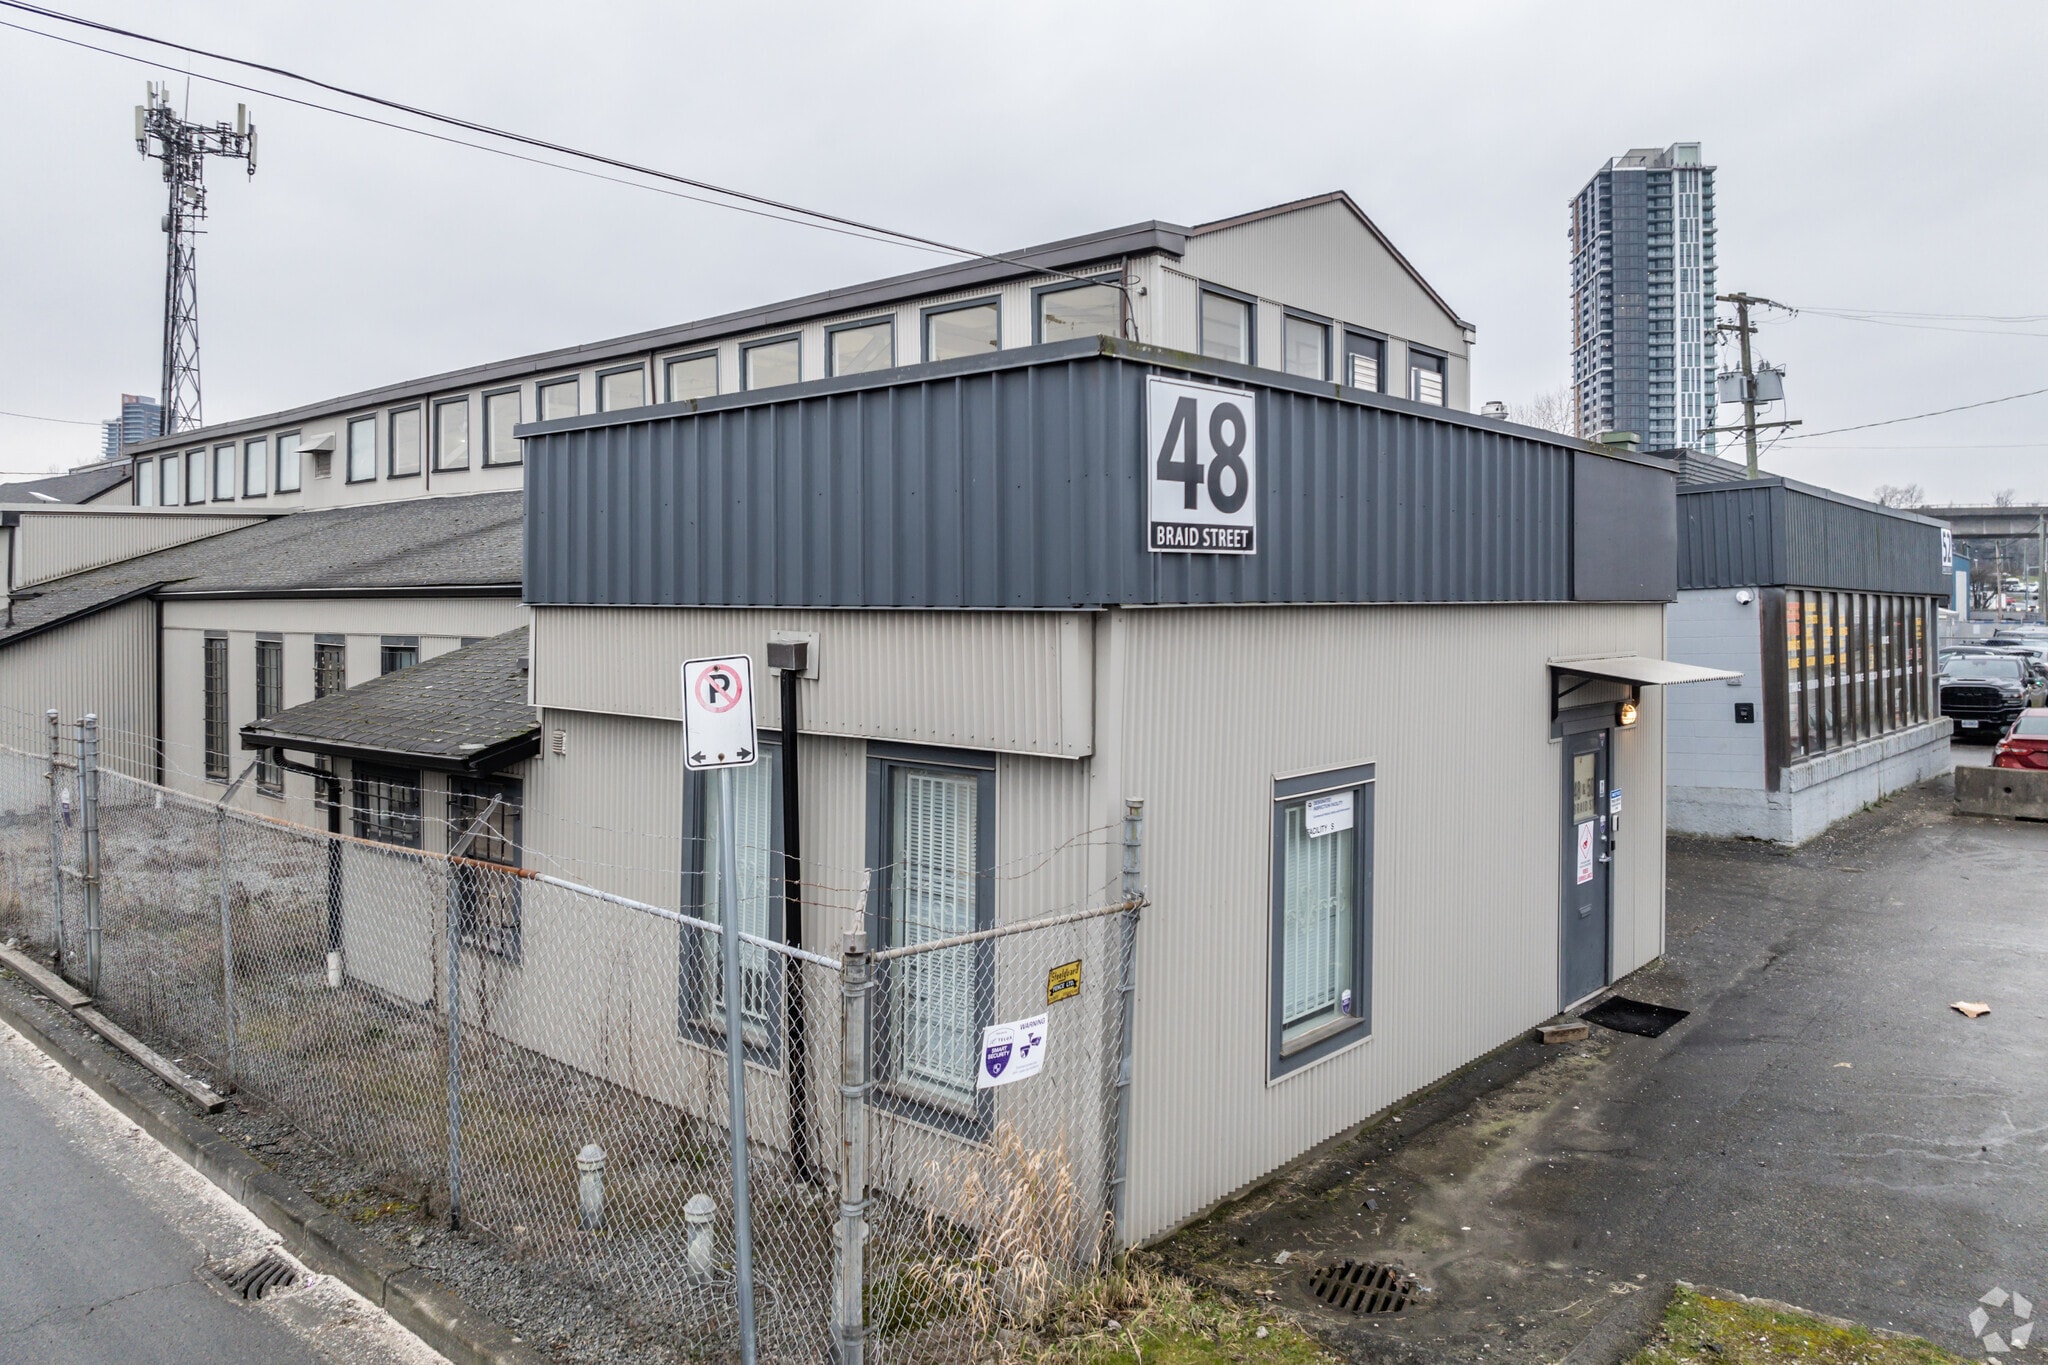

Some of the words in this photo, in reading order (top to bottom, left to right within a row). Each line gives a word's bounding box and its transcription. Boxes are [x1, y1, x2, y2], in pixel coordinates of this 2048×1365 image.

[1157, 396, 1248, 514] 48
[1157, 526, 1199, 546] BRAID
[1203, 528, 1248, 547] STREET
[1943, 531, 1951, 562] 52
[1053, 983, 1065, 992] FENCE
[1020, 1017, 1045, 1030] WARNING
[987, 1051, 1010, 1060] SECURITY
[991, 1046, 1007, 1054] SMART
